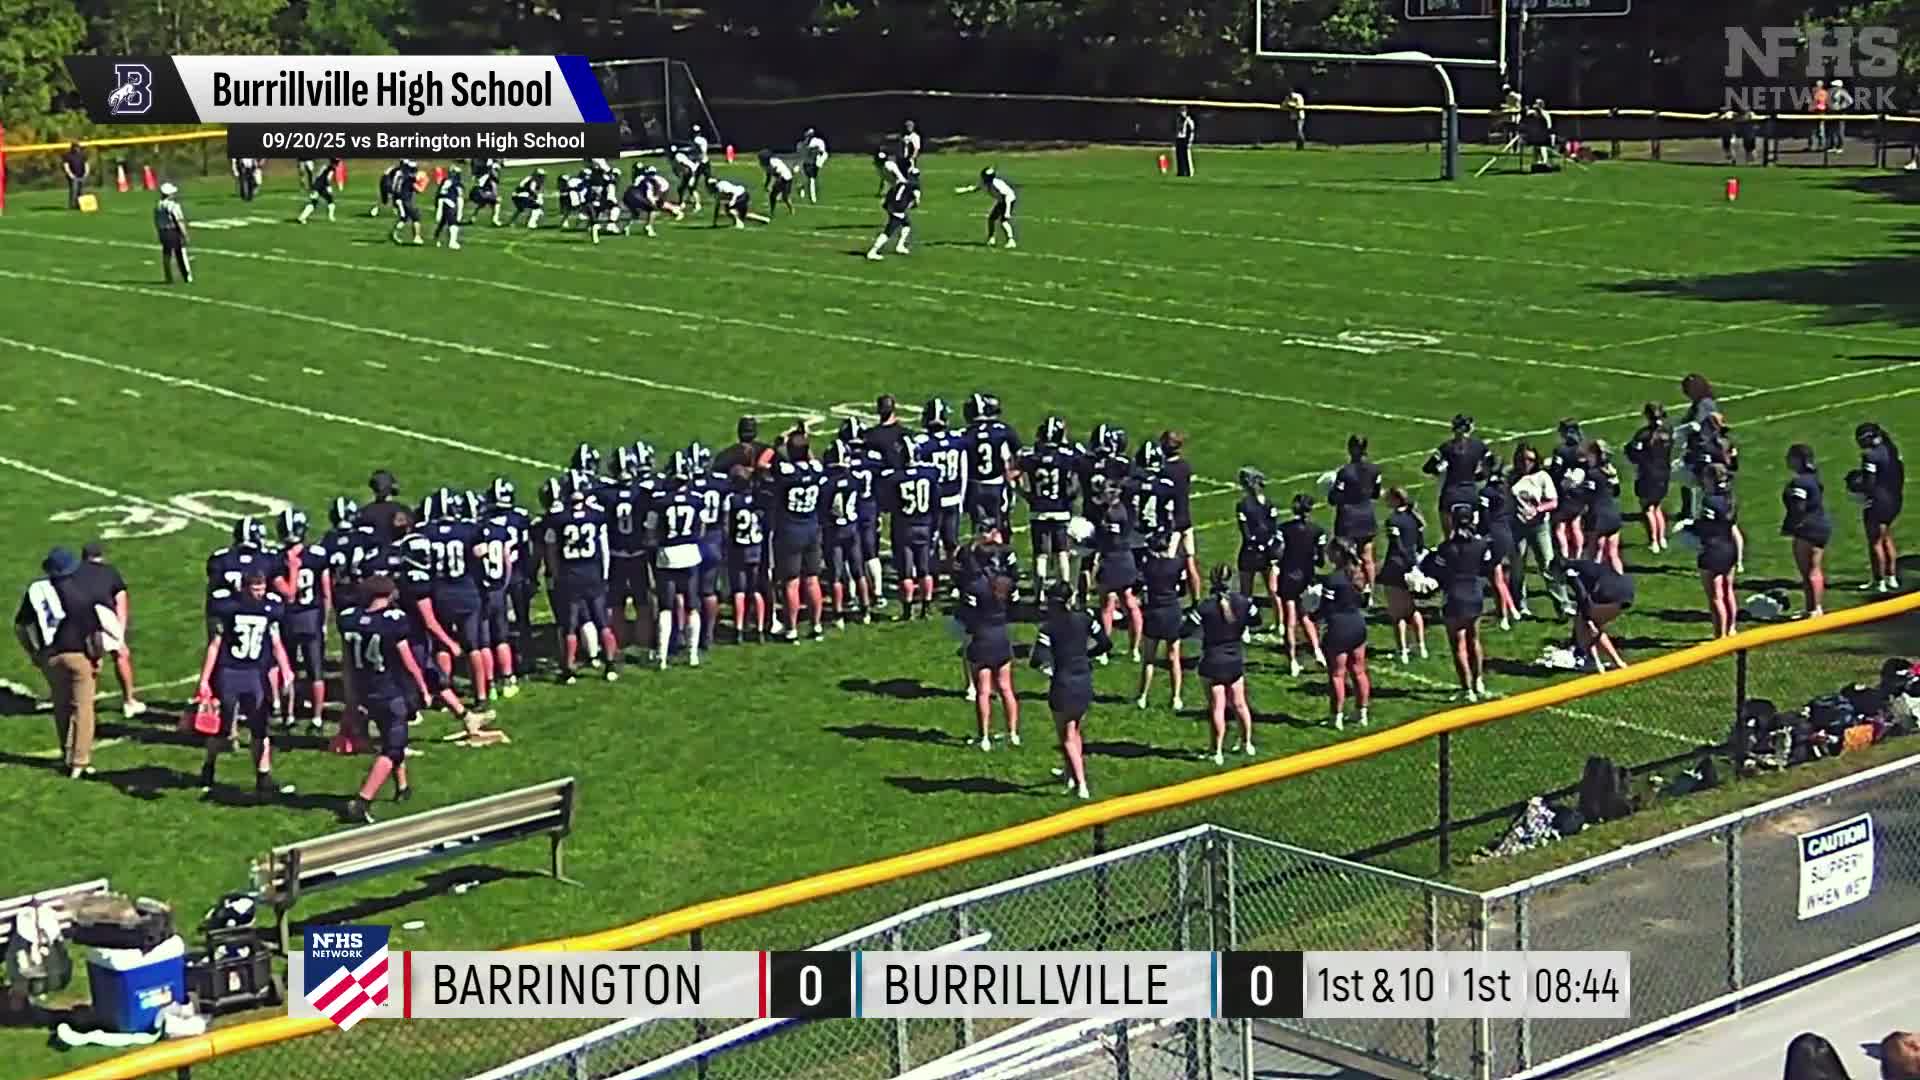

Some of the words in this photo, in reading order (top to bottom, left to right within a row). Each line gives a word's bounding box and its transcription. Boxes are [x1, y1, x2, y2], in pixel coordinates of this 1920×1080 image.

[977, 442, 993, 475] 3
[899, 478, 930, 514] 50
[665, 504, 696, 540] 17
[563, 522, 597, 560] 23
[1807, 822, 1868, 857] CAUTION
